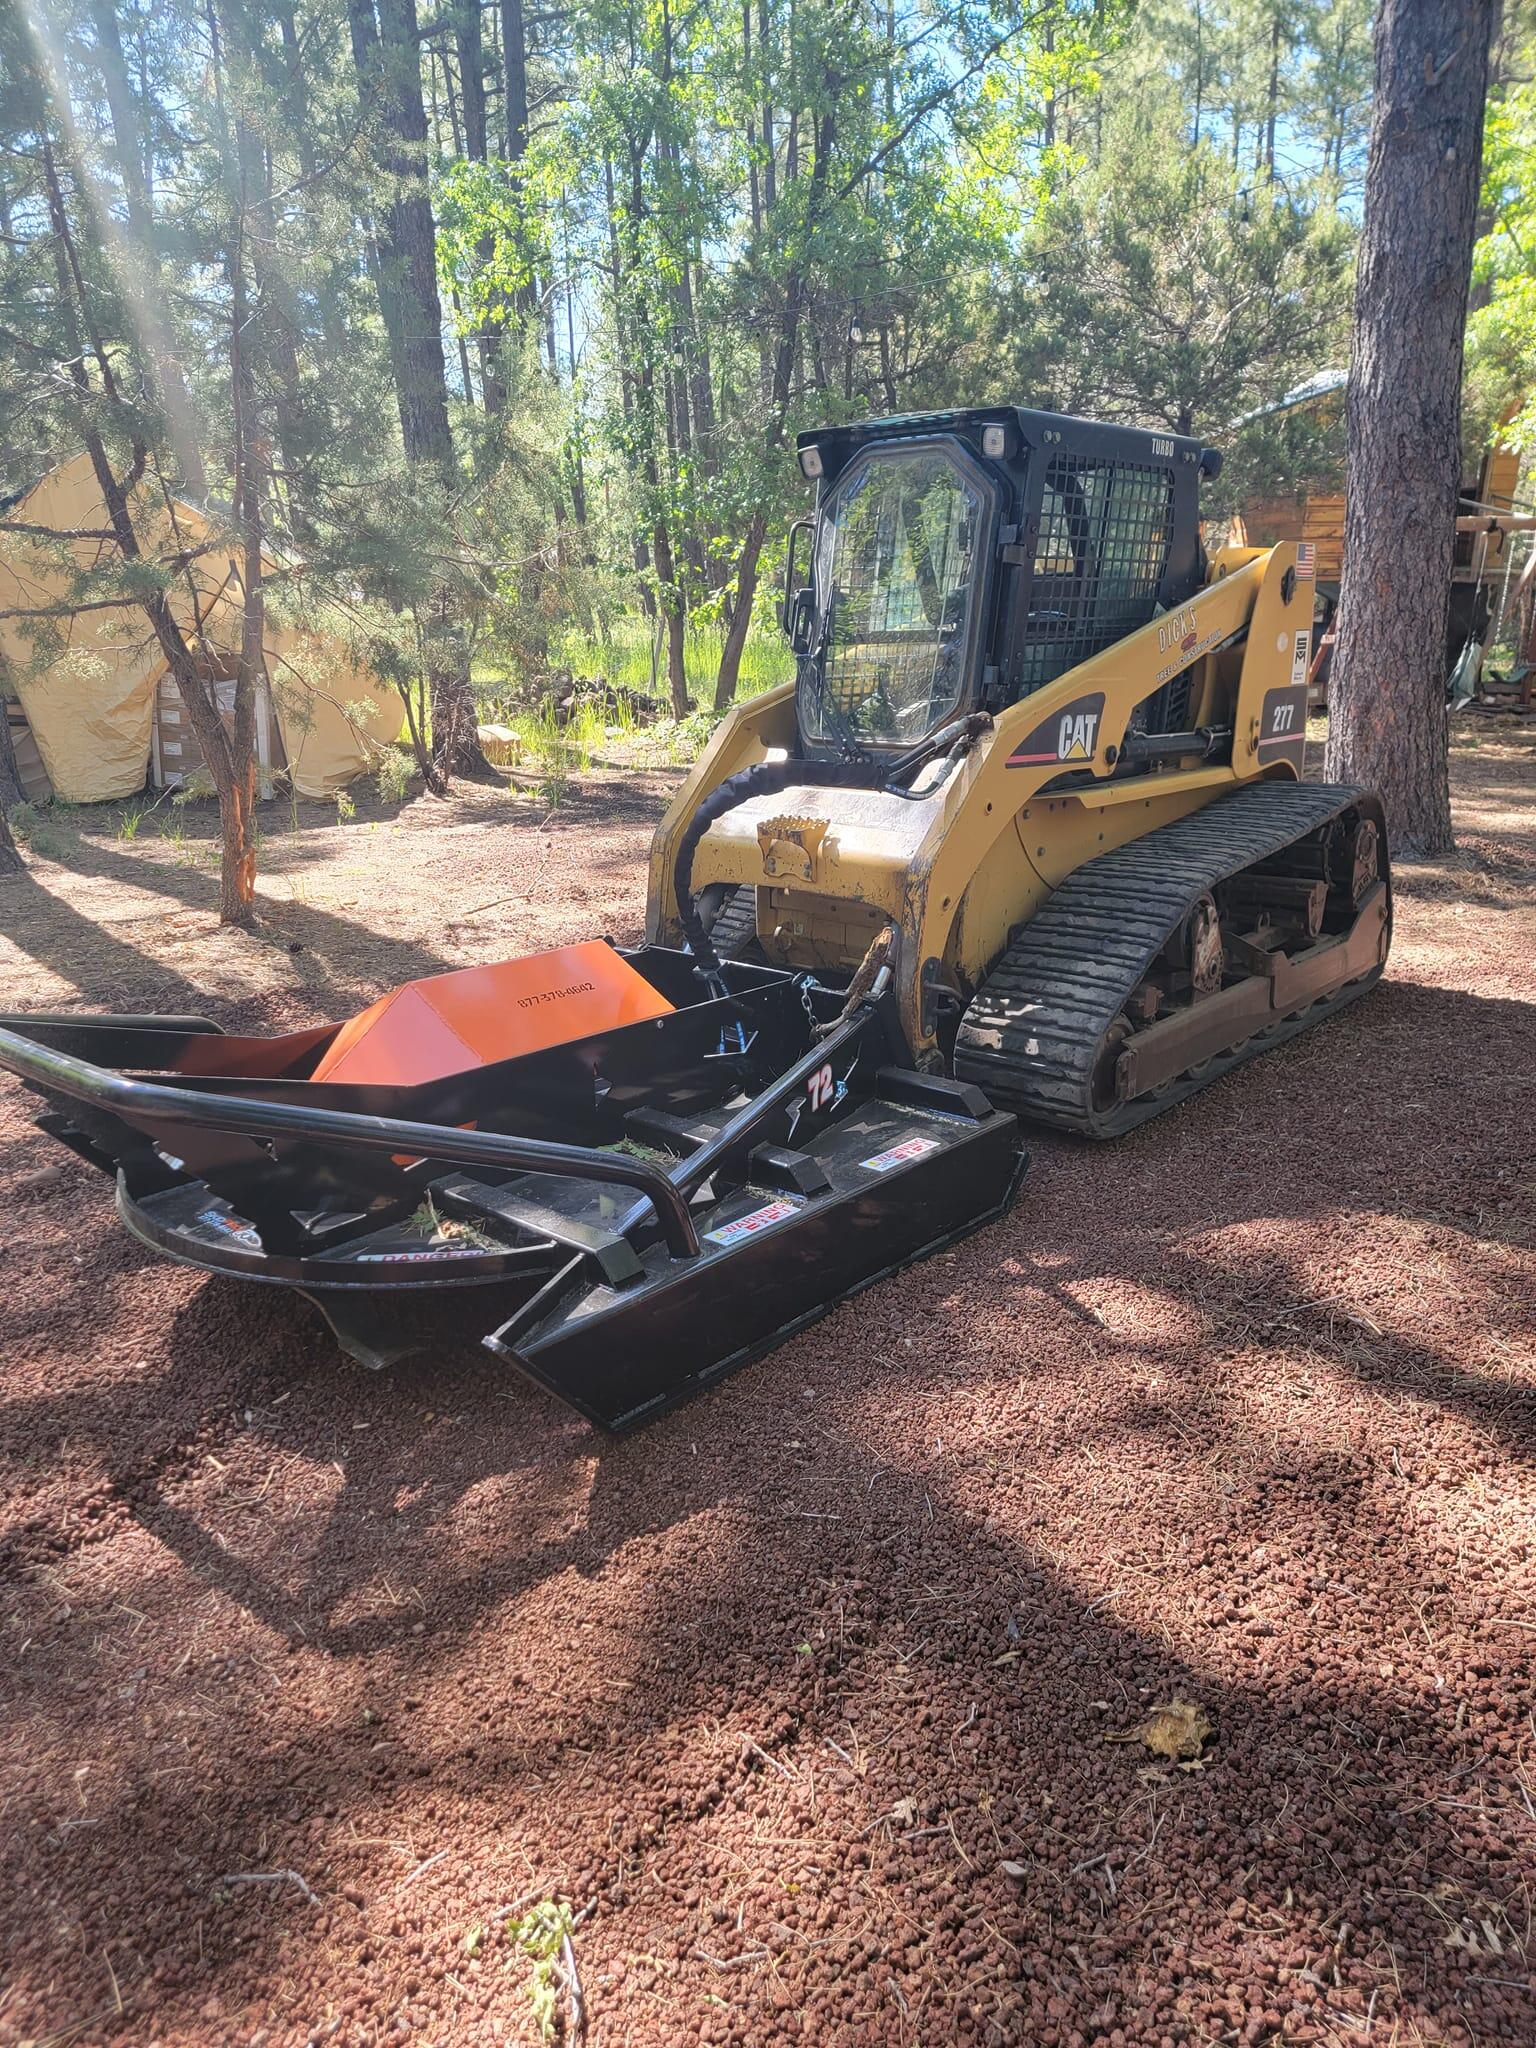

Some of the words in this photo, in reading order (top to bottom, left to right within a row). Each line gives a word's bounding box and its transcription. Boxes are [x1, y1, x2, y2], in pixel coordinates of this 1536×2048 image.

[1151, 437, 1175, 457] TURBO
[1272, 704, 1295, 732] 277
[1058, 714, 1098, 760] CAT
[517, 982, 596, 1008] 877-378-4642
[807, 1063, 834, 1113] 72
[873, 1139, 926, 1162] WARNING
[721, 1202, 785, 1233] WARNING
